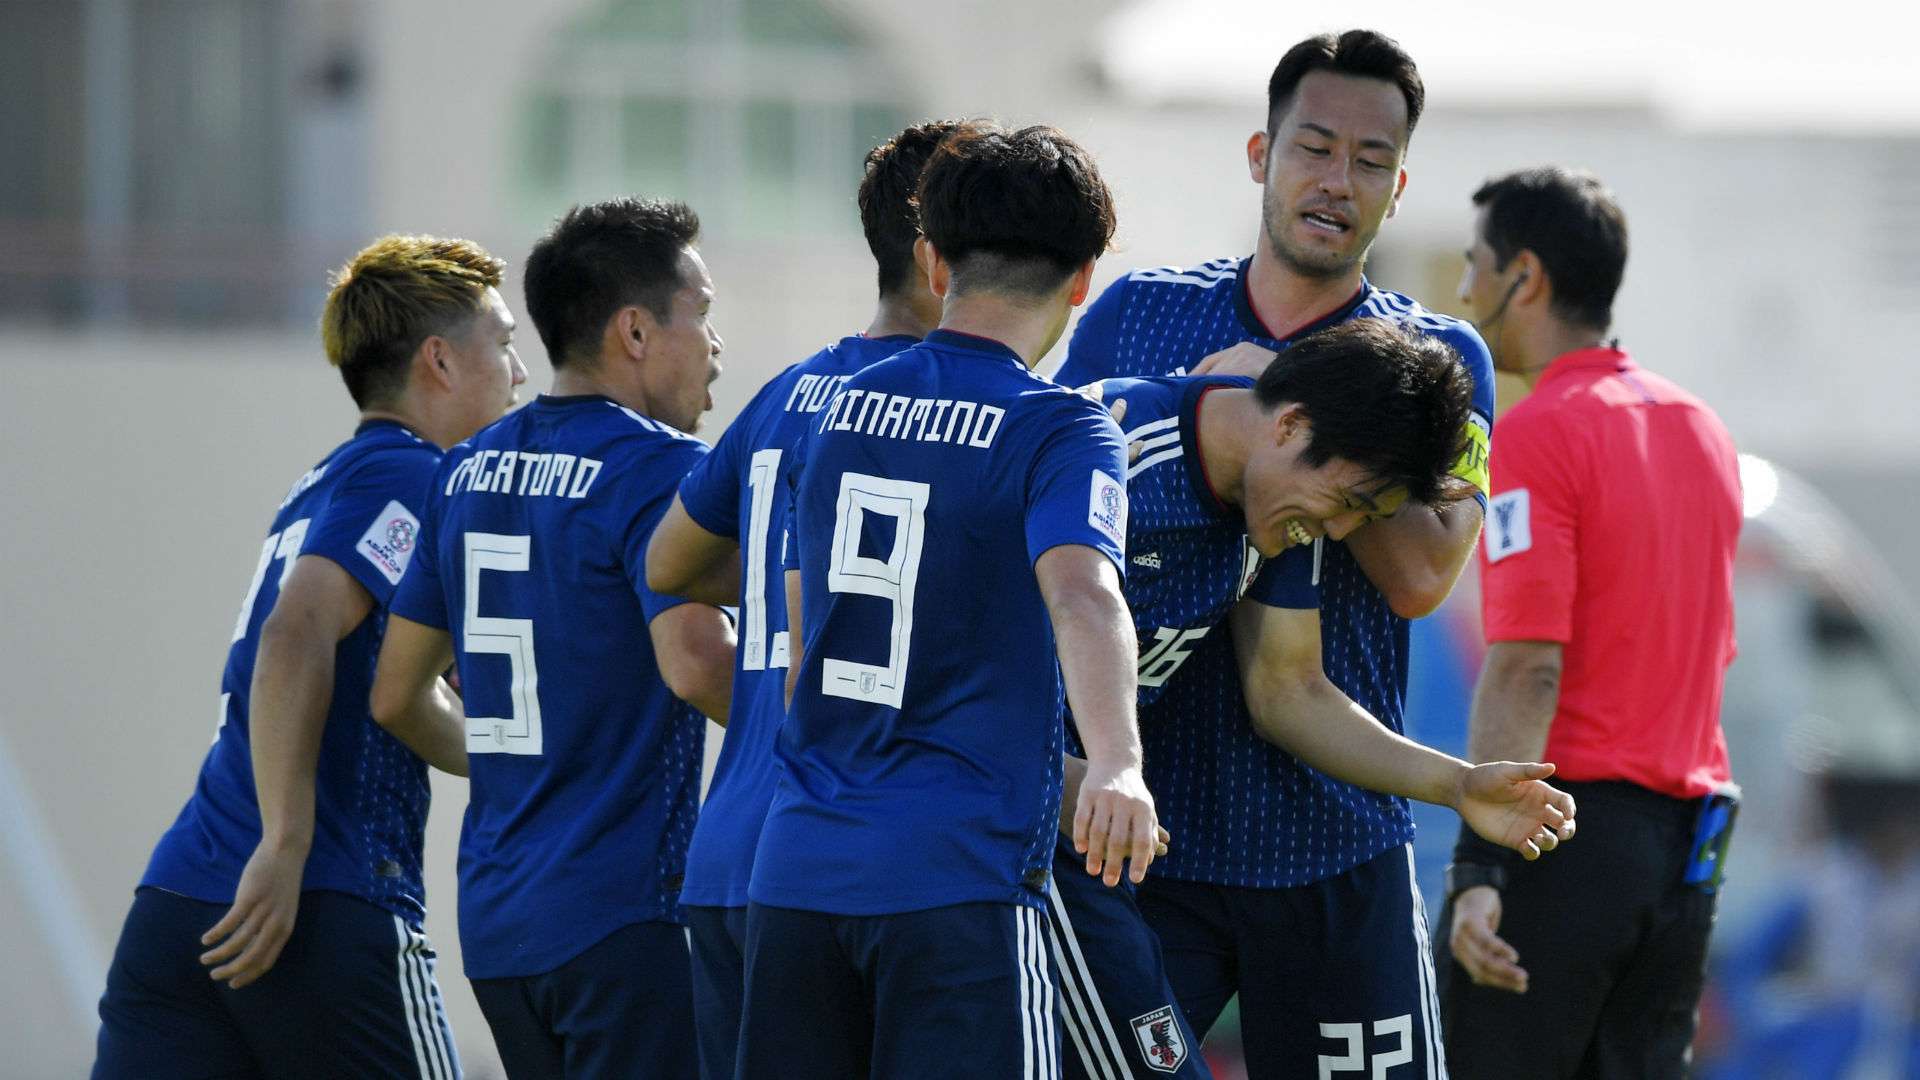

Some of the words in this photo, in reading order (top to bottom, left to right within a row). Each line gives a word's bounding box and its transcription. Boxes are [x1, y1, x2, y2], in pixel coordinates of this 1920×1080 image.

[818, 389, 1006, 449] MINAMINO
[444, 449, 604, 499] NAGATOMO
[822, 471, 931, 710] 9
[1133, 554, 1161, 569] adidas
[463, 531, 544, 756] 5
[1137, 626, 1211, 688] 16
[1142, 1011, 1165, 1024] JAPAN
[1317, 1013, 1413, 1080] 22
